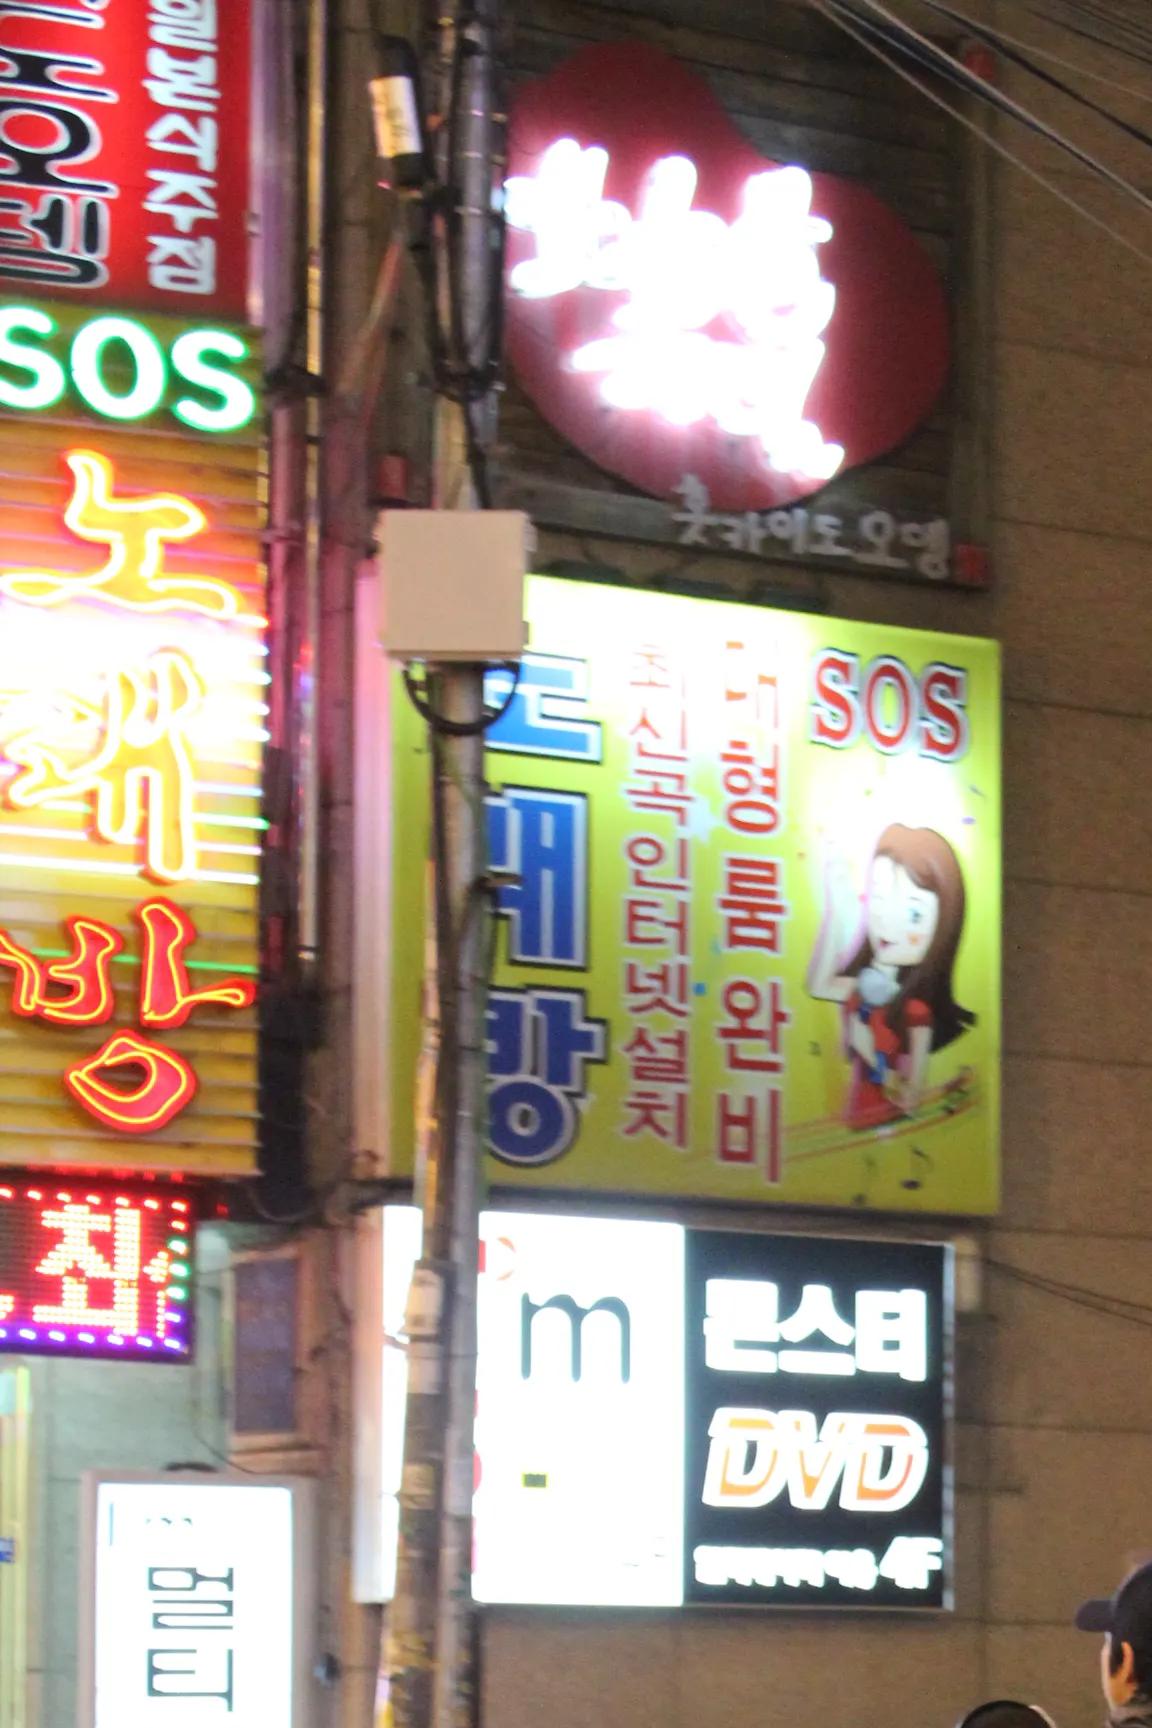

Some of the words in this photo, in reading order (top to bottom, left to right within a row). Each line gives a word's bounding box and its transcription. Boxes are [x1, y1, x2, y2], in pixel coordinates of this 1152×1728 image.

[0, 305, 256, 432] SOS
[811, 648, 968, 762] SOS
[702, 1407, 928, 1511] DVD
